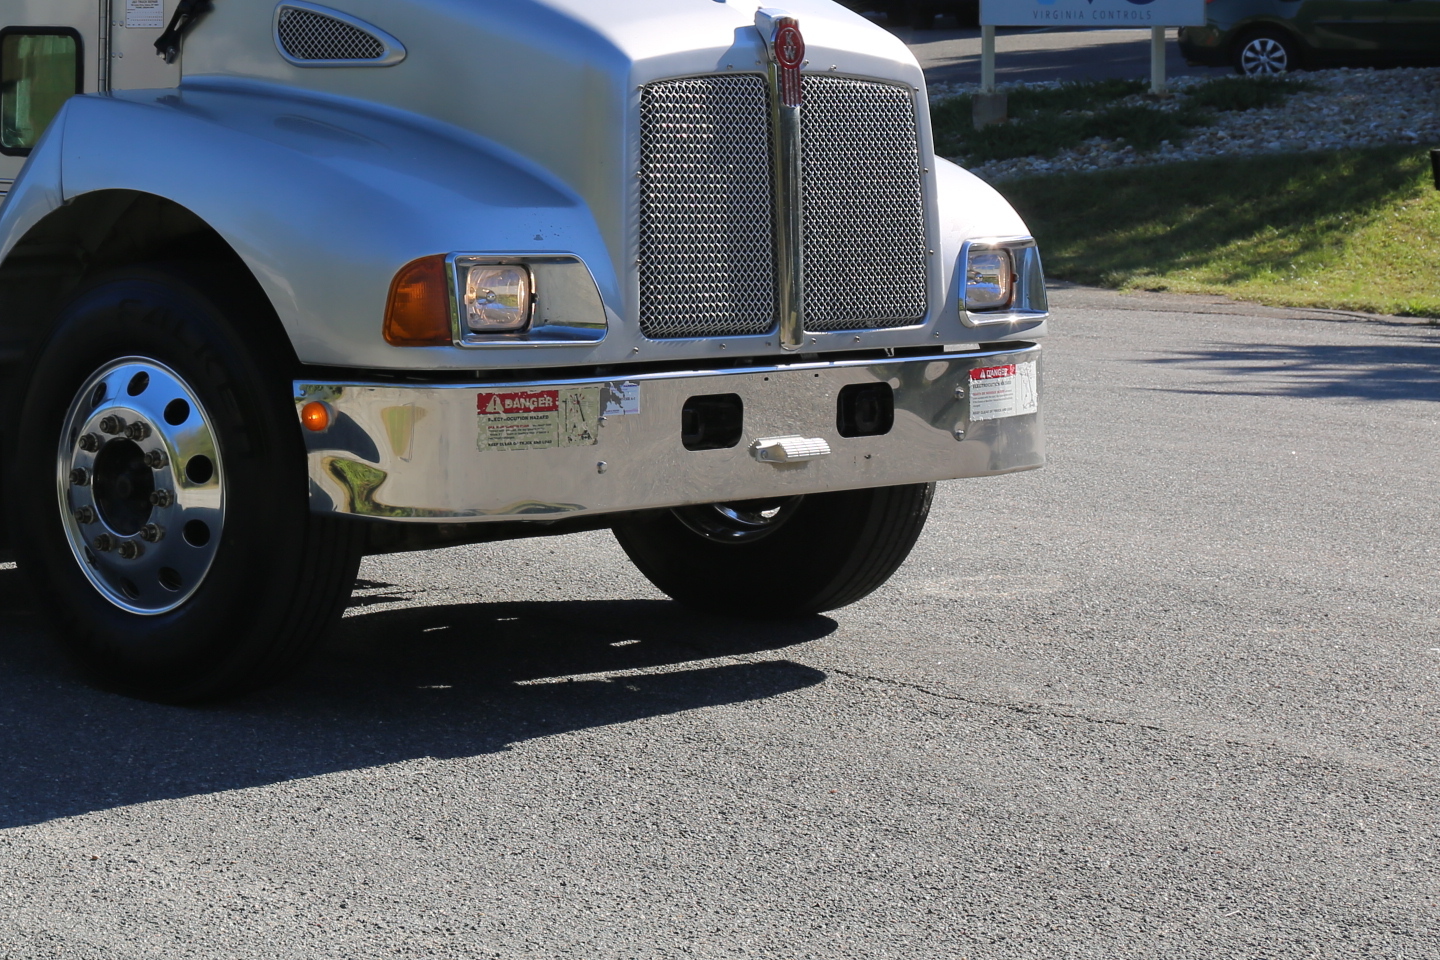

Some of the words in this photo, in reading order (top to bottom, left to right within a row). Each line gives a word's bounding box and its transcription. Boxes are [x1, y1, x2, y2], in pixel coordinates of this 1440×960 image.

[1033, 10, 1084, 20] VIRGINIA
[1092, 9, 1152, 20] CONTROLS
[504, 396, 553, 409] DANGER
